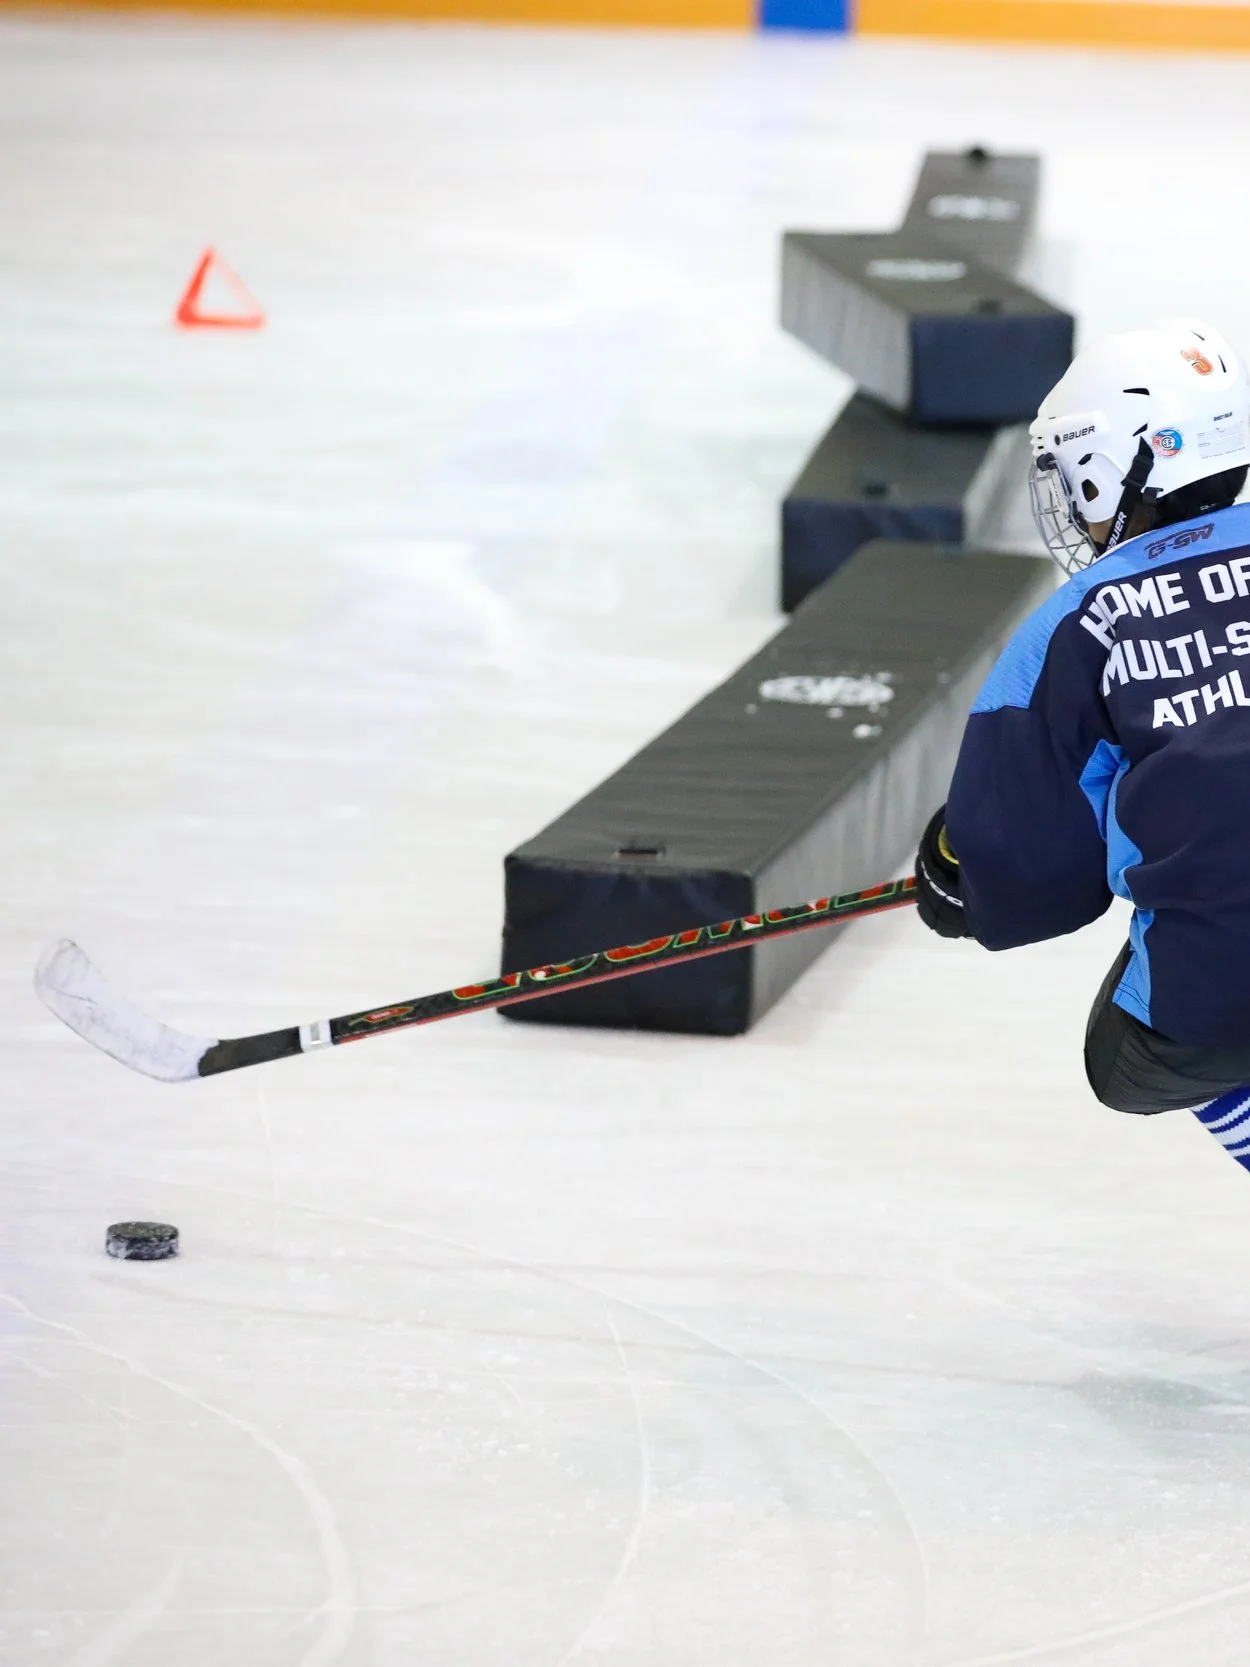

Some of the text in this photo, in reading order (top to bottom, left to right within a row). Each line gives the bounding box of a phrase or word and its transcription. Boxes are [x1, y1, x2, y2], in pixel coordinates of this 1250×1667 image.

[1063, 425, 1096, 442] BAUER
[1106, 512, 1127, 550] AUER
[1080, 573, 1190, 650] HOME
